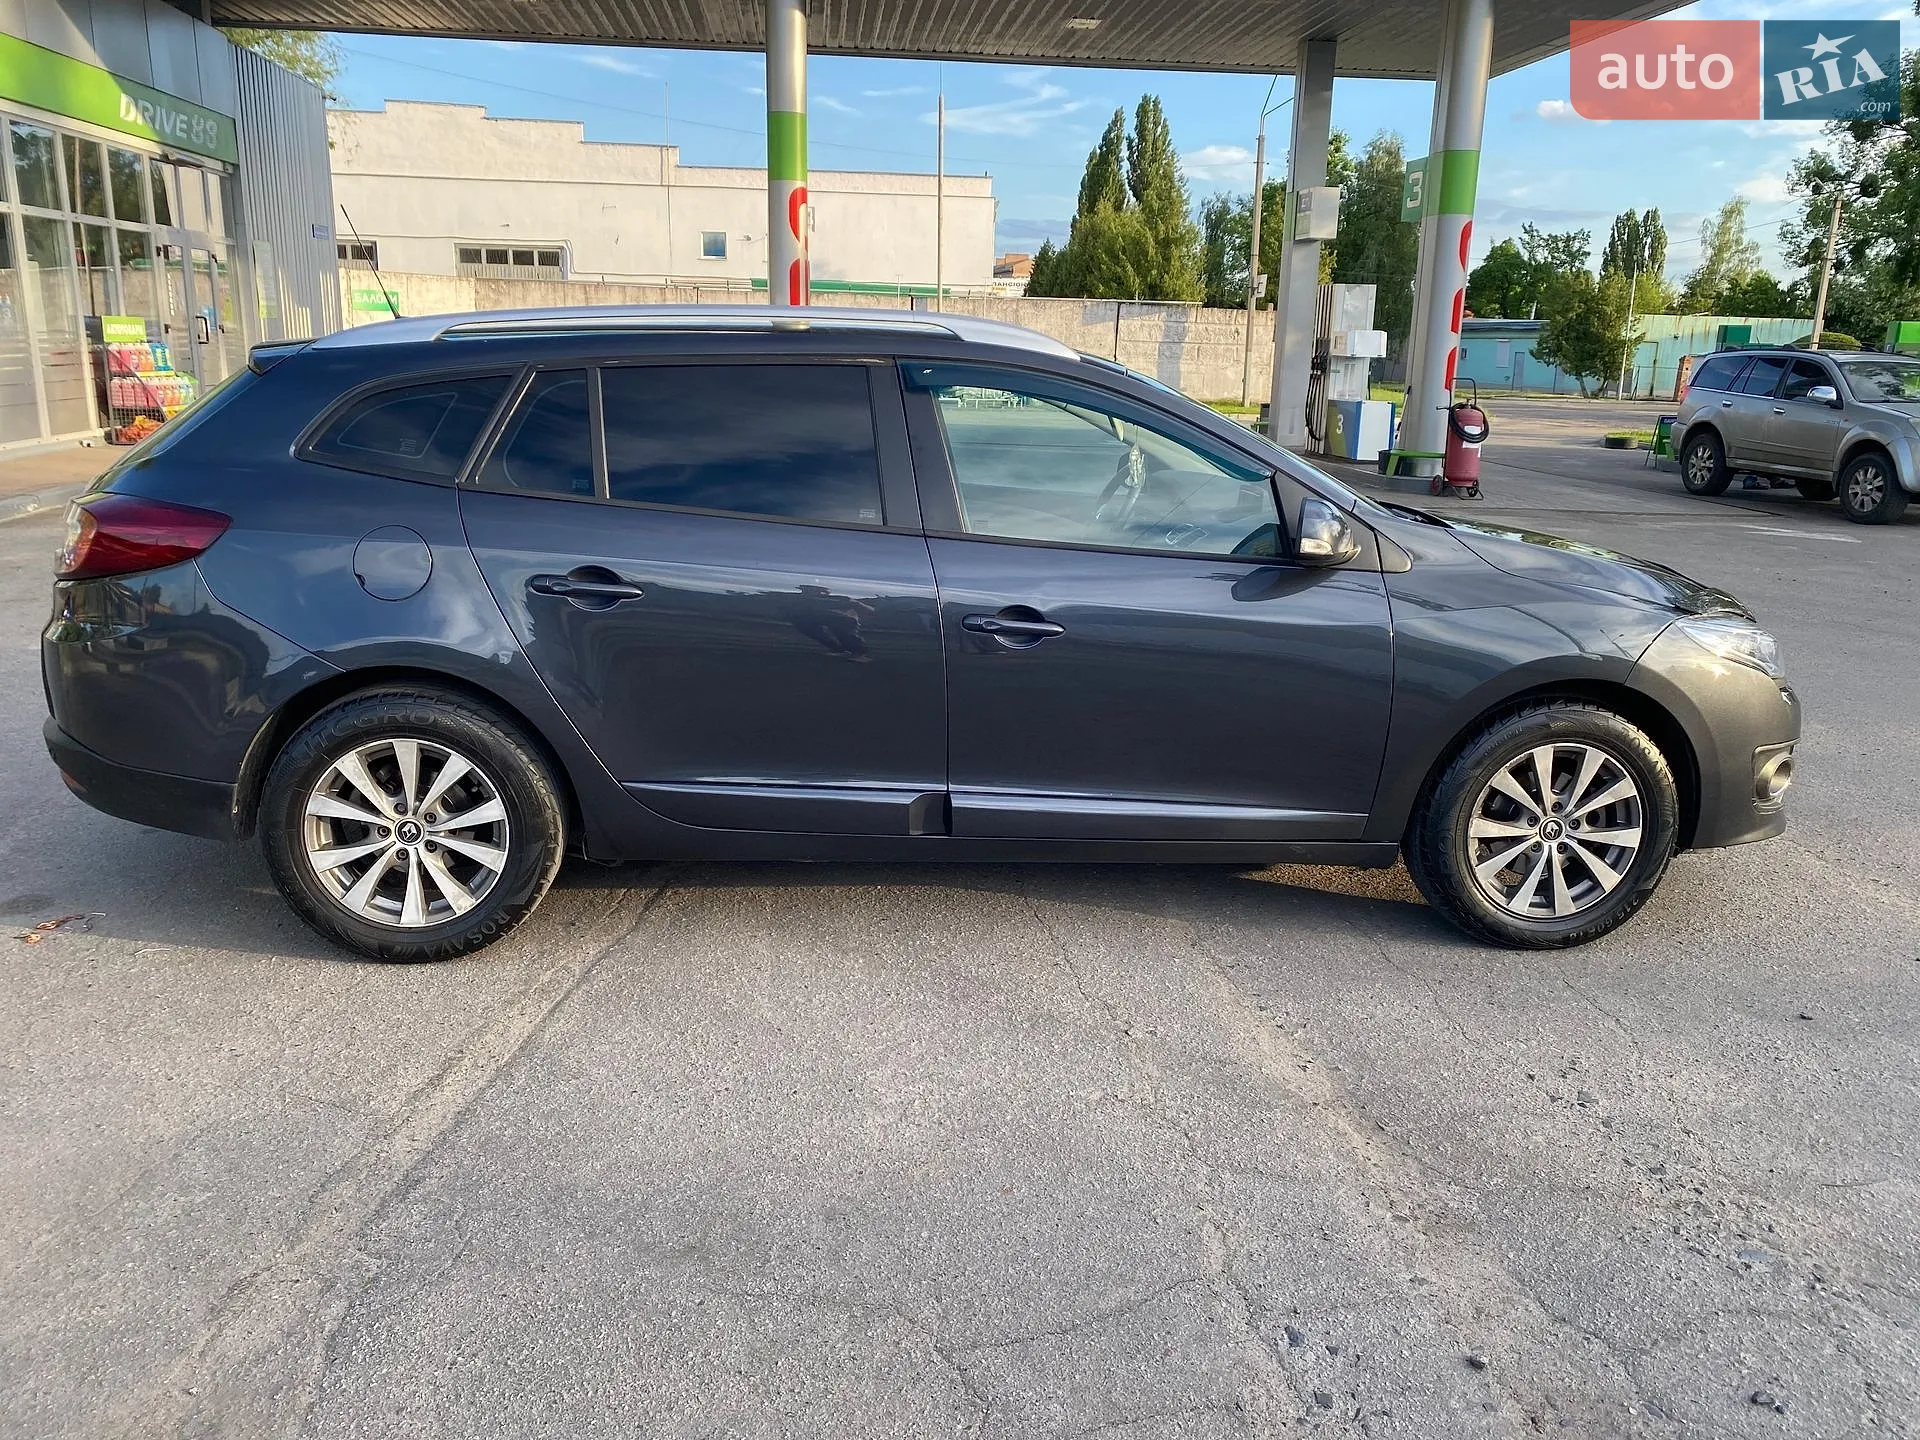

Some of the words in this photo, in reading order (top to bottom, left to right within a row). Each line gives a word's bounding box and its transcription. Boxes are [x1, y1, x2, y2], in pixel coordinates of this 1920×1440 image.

[119, 92, 188, 140] DRIVE
[1406, 171, 1424, 208] 3
[1336, 414, 1344, 435] 3
